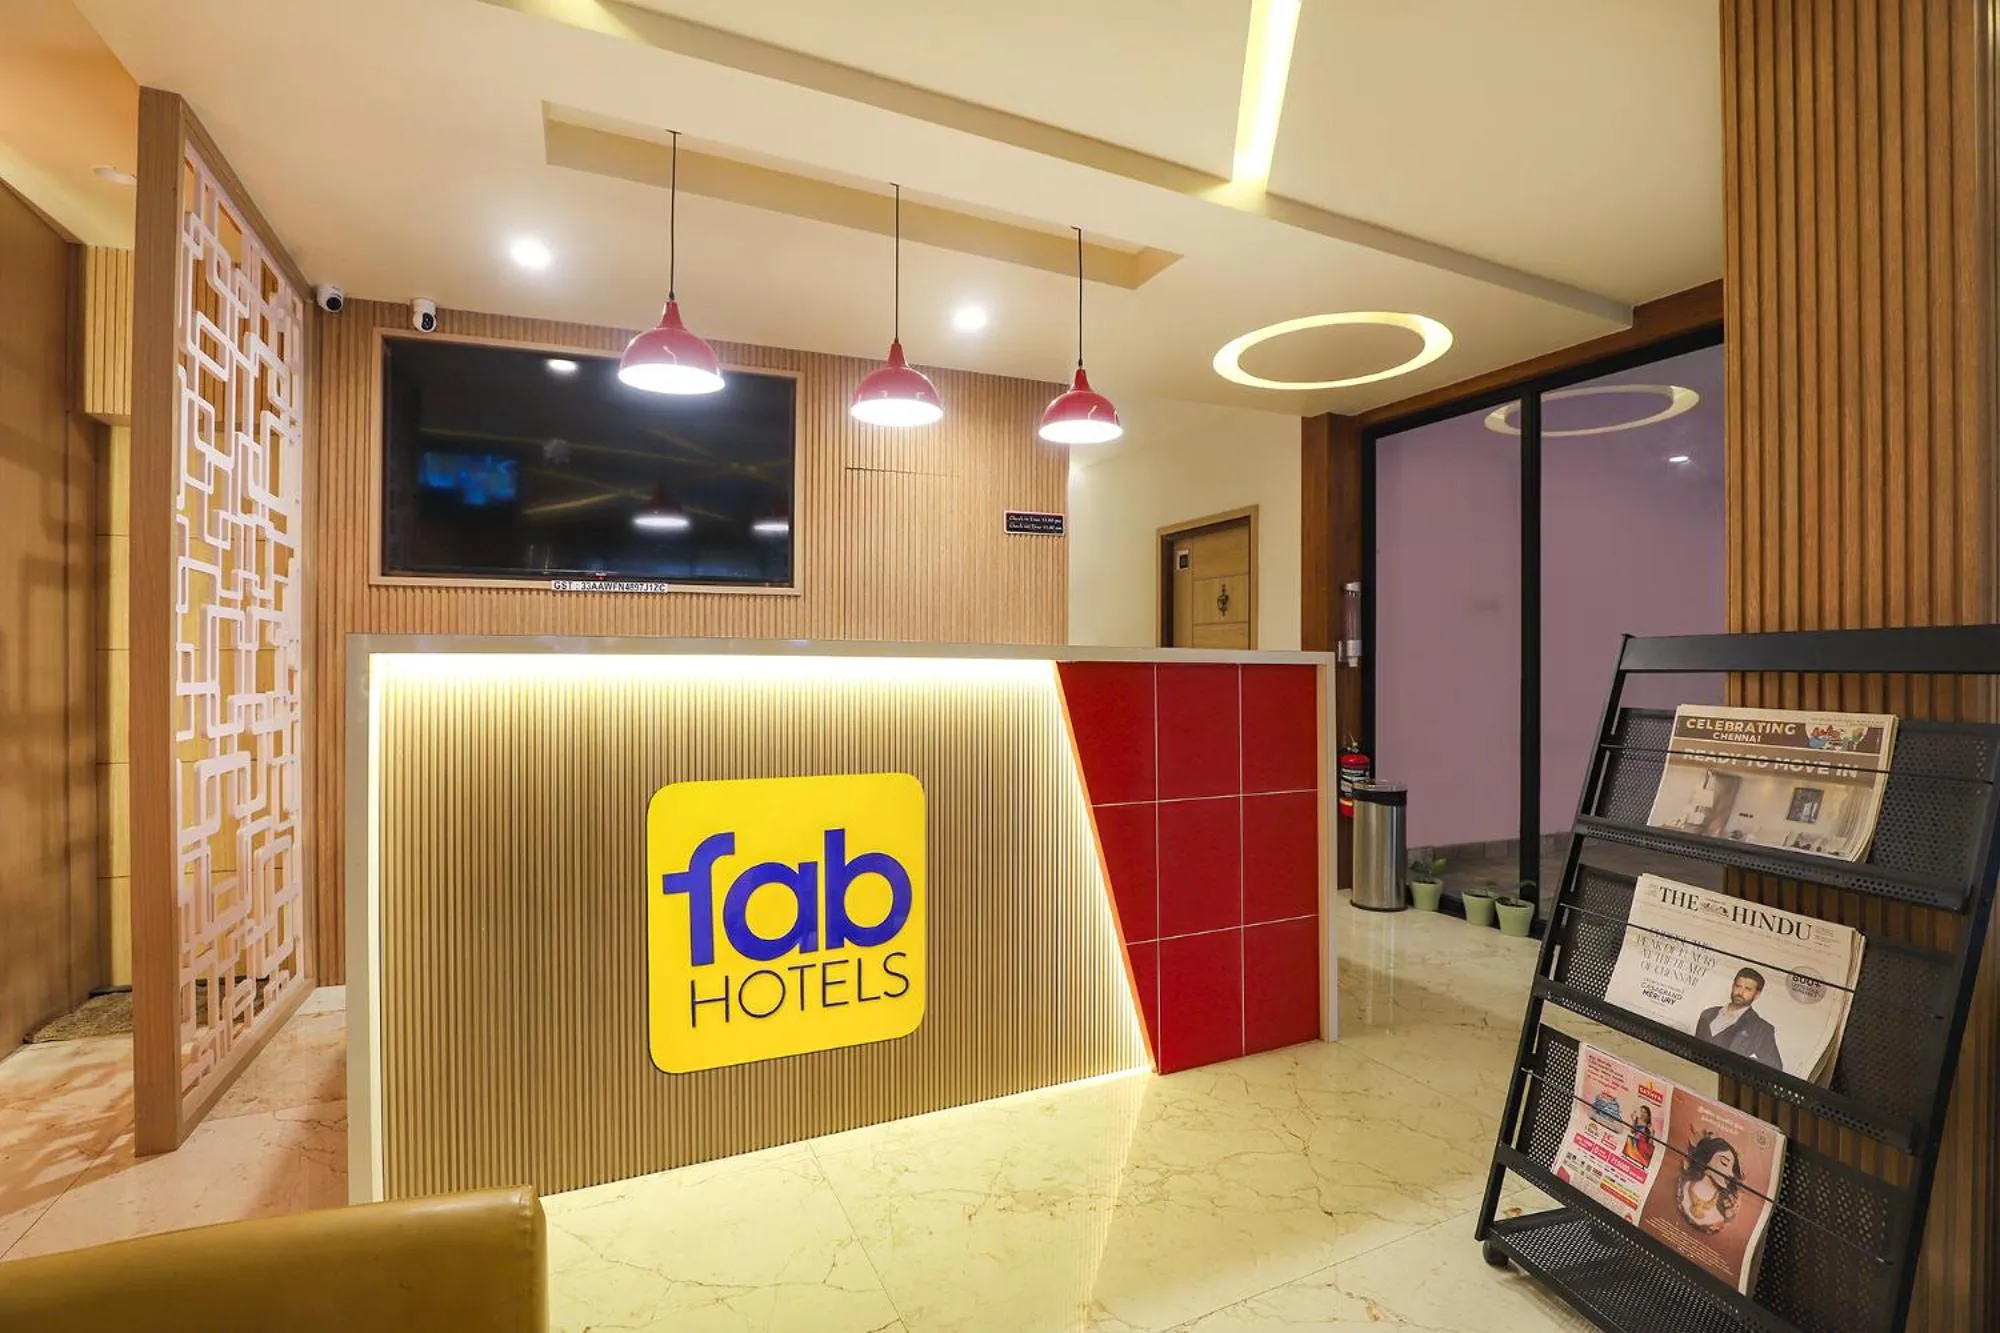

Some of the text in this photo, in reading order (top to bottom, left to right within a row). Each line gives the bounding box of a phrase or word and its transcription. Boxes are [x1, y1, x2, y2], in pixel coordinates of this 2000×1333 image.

[554, 580, 572, 590] GST
[1686, 718, 1796, 736] CELEBRATING
[1712, 732, 1761, 743] CHENNAI
[1682, 748, 1860, 778] READY TO MOVE IN
[662, 828, 912, 967] fab
[1659, 886, 1700, 912] THE
[1731, 905, 1812, 941] HINDU
[691, 952, 909, 1028] HOTELS
